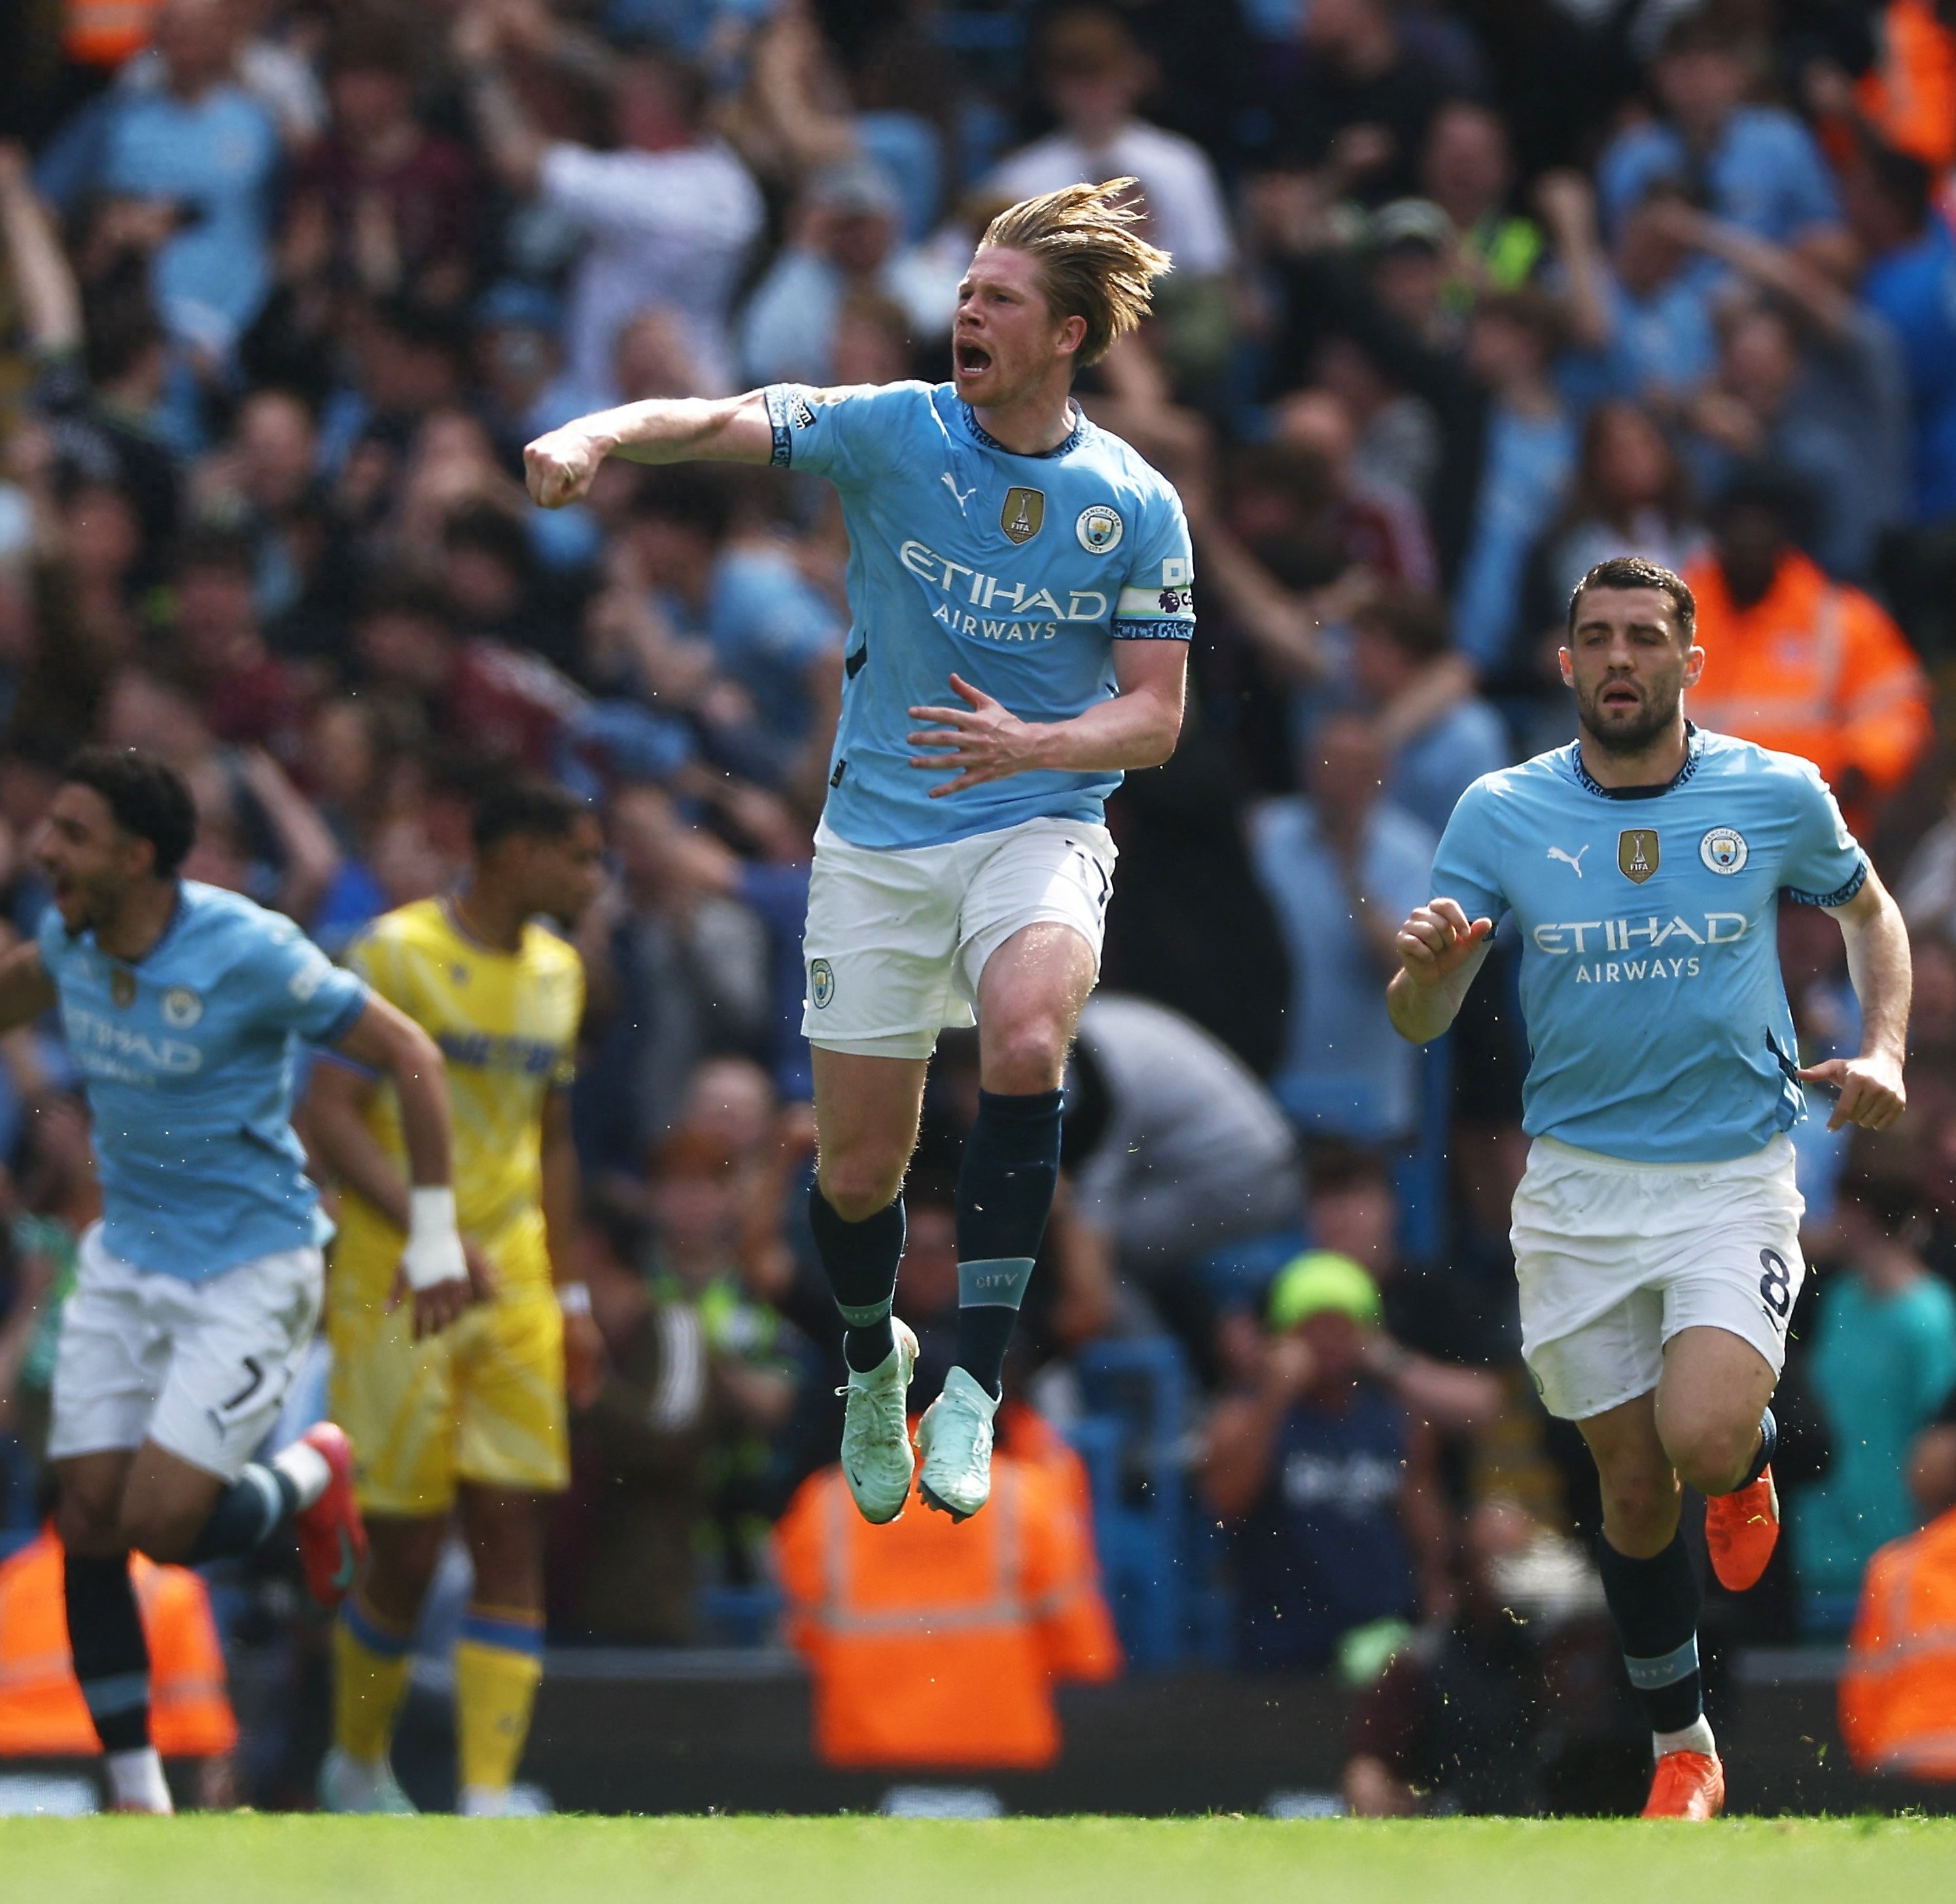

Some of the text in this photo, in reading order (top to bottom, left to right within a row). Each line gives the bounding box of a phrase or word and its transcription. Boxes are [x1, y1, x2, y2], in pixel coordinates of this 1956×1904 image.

[1011, 523, 1030, 531] FIFA
[1081, 508, 1120, 527] MANCHESTER
[900, 540, 1107, 620] ETIHAD
[932, 603, 1057, 641] AIRWAYS
[1703, 830, 1743, 846] MANCHESTER
[1533, 912, 1747, 955] ETIHAD
[1575, 957, 1700, 983] AIRWAYS
[976, 1273, 1019, 1288] CITY
[1760, 1248, 1789, 1317] 8
